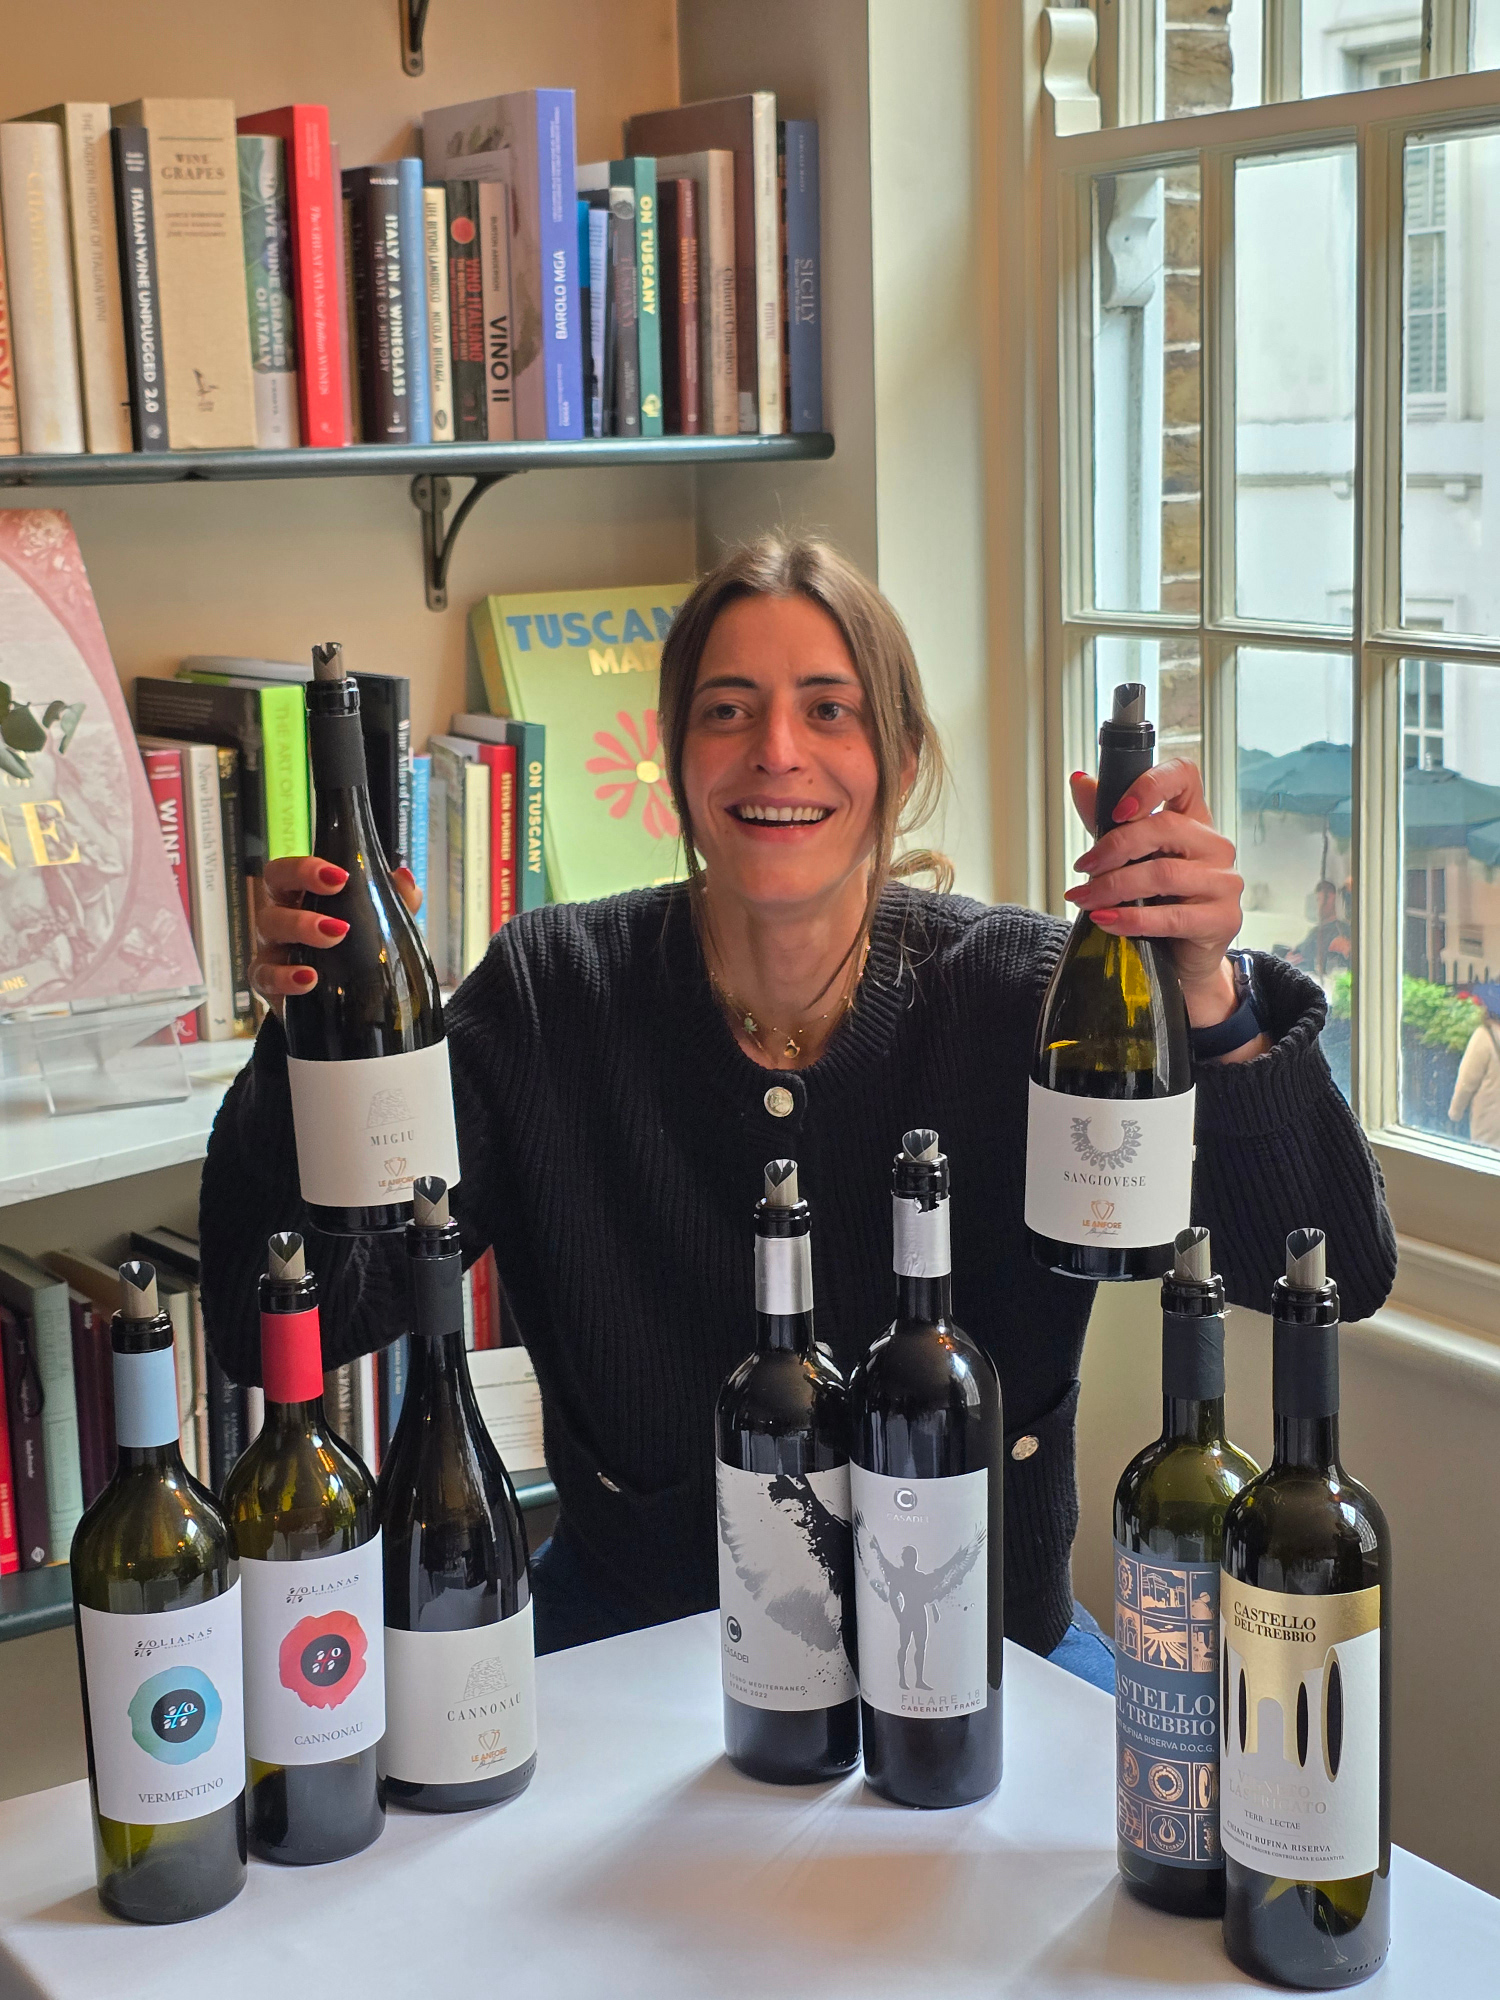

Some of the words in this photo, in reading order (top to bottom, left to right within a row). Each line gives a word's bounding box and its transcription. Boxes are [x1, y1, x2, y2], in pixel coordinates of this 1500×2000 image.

[81, 113, 92, 133] THE
[84, 136, 97, 185] MODERN
[161, 166, 225, 181] GRAPES
[174, 153, 209, 165] WINE
[87, 188, 101, 230] HISTORY
[130, 187, 147, 245] ITALIAN
[262, 173, 278, 238] NATIVE
[640, 195, 653, 224] ON
[90, 239, 100, 250] OF
[373, 240, 385, 260] THE
[385, 214, 399, 259] ITALY
[427, 222, 439, 253] BEYOND
[92, 253, 105, 292] ITALIAN
[135, 248, 150, 289] WINE
[267, 242, 281, 290] WINE
[375, 265, 387, 298] TASTE
[387, 264, 401, 282] IN
[429, 256, 441, 303] LAMBRUSCO
[466, 258, 482, 293] VINO
[491, 249, 500, 292] ANDERSON
[554, 250, 566, 283] MGA
[640, 228, 655, 315] TUSCANY
[256, 287, 269, 312] OF
[388, 285, 402, 299] A
[723, 267, 734, 317] Chianti
[800, 258, 815, 325] SICILY
[95, 296, 106, 322] WINE
[377, 303, 388, 320] OF
[555, 284, 568, 340] BAROLO
[138, 290, 157, 383] UNPLUGGED
[258, 317, 272, 367] ITALY
[270, 293, 285, 366] GRAPES
[431, 312, 443, 344] NICOLAS
[468, 296, 484, 363] ITALIANO
[378, 325, 390, 373] HISTORY
[389, 304, 406, 397] WINEGLASS
[490, 315, 510, 382] VINO
[724, 320, 735, 375] Classico
[318, 355, 330, 396] WINES
[433, 347, 445, 383] BELFRAGE
[144, 388, 160, 413] 2.0
[491, 388, 510, 403] II
[275, 703, 290, 738] THE
[278, 742, 292, 772] ART
[196, 762, 211, 794] New
[279, 778, 293, 798] OF
[529, 760, 542, 787] ON
[501, 772, 512, 810] STEVEN
[200, 797, 217, 850] British
[281, 803, 296, 856] VINTA
[396, 800, 410, 856] Germany
[501, 811, 512, 861] SPURRIER
[527, 791, 542, 874] TUSCANY
[203, 851, 218, 892] Wine
[501, 867, 511, 877] A
[501, 877, 511, 898] LIFE
[370, 1130, 415, 1147] MIGIU
[378, 1179, 386, 1187] LE
[1063, 1170, 1146, 1188] SANGIOVESE
[1082, 1219, 1090, 1227] LE
[1091, 1220, 1122, 1229] ANFORE
[886, 1512, 930, 1524] CASADEI
[300, 1574, 360, 1593] OLIANAS
[1234, 1600, 1317, 1631] CASTELLO
[1234, 1614, 1255, 1634] DEL
[1255, 1623, 1317, 1643] TREBBIO
[148, 1626, 213, 1648] OLIANAS
[724, 1644, 749, 1664] CASADEI
[729, 1680, 748, 1694] SYRAH
[750, 1689, 768, 1699] 2022
[748, 1680, 806, 1692] MEDITERRANEO
[901, 1693, 958, 1706] FILARE
[966, 1689, 981, 1699] 18
[447, 1692, 522, 1722] CANNONAU
[901, 1703, 950, 1713] CABERNET
[954, 1699, 981, 1711] FRANC
[1126, 1702, 1216, 1737] TREBBIO
[294, 1722, 364, 1746] CANNONAU
[1144, 1734, 1178, 1751] RISERVA
[1180, 1743, 1215, 1753] D.O.C.G.
[471, 1755, 480, 1763] LE
[481, 1746, 508, 1761] ANFORE
[138, 1777, 224, 1804] VERMENTINO
[1226, 1819, 1253, 1841] CHIANTI
[1254, 1836, 1289, 1851] RUFINA
[1291, 1843, 1331, 1853] RISERVA
[1271, 1850, 1310, 1861] CONTROLLATA
